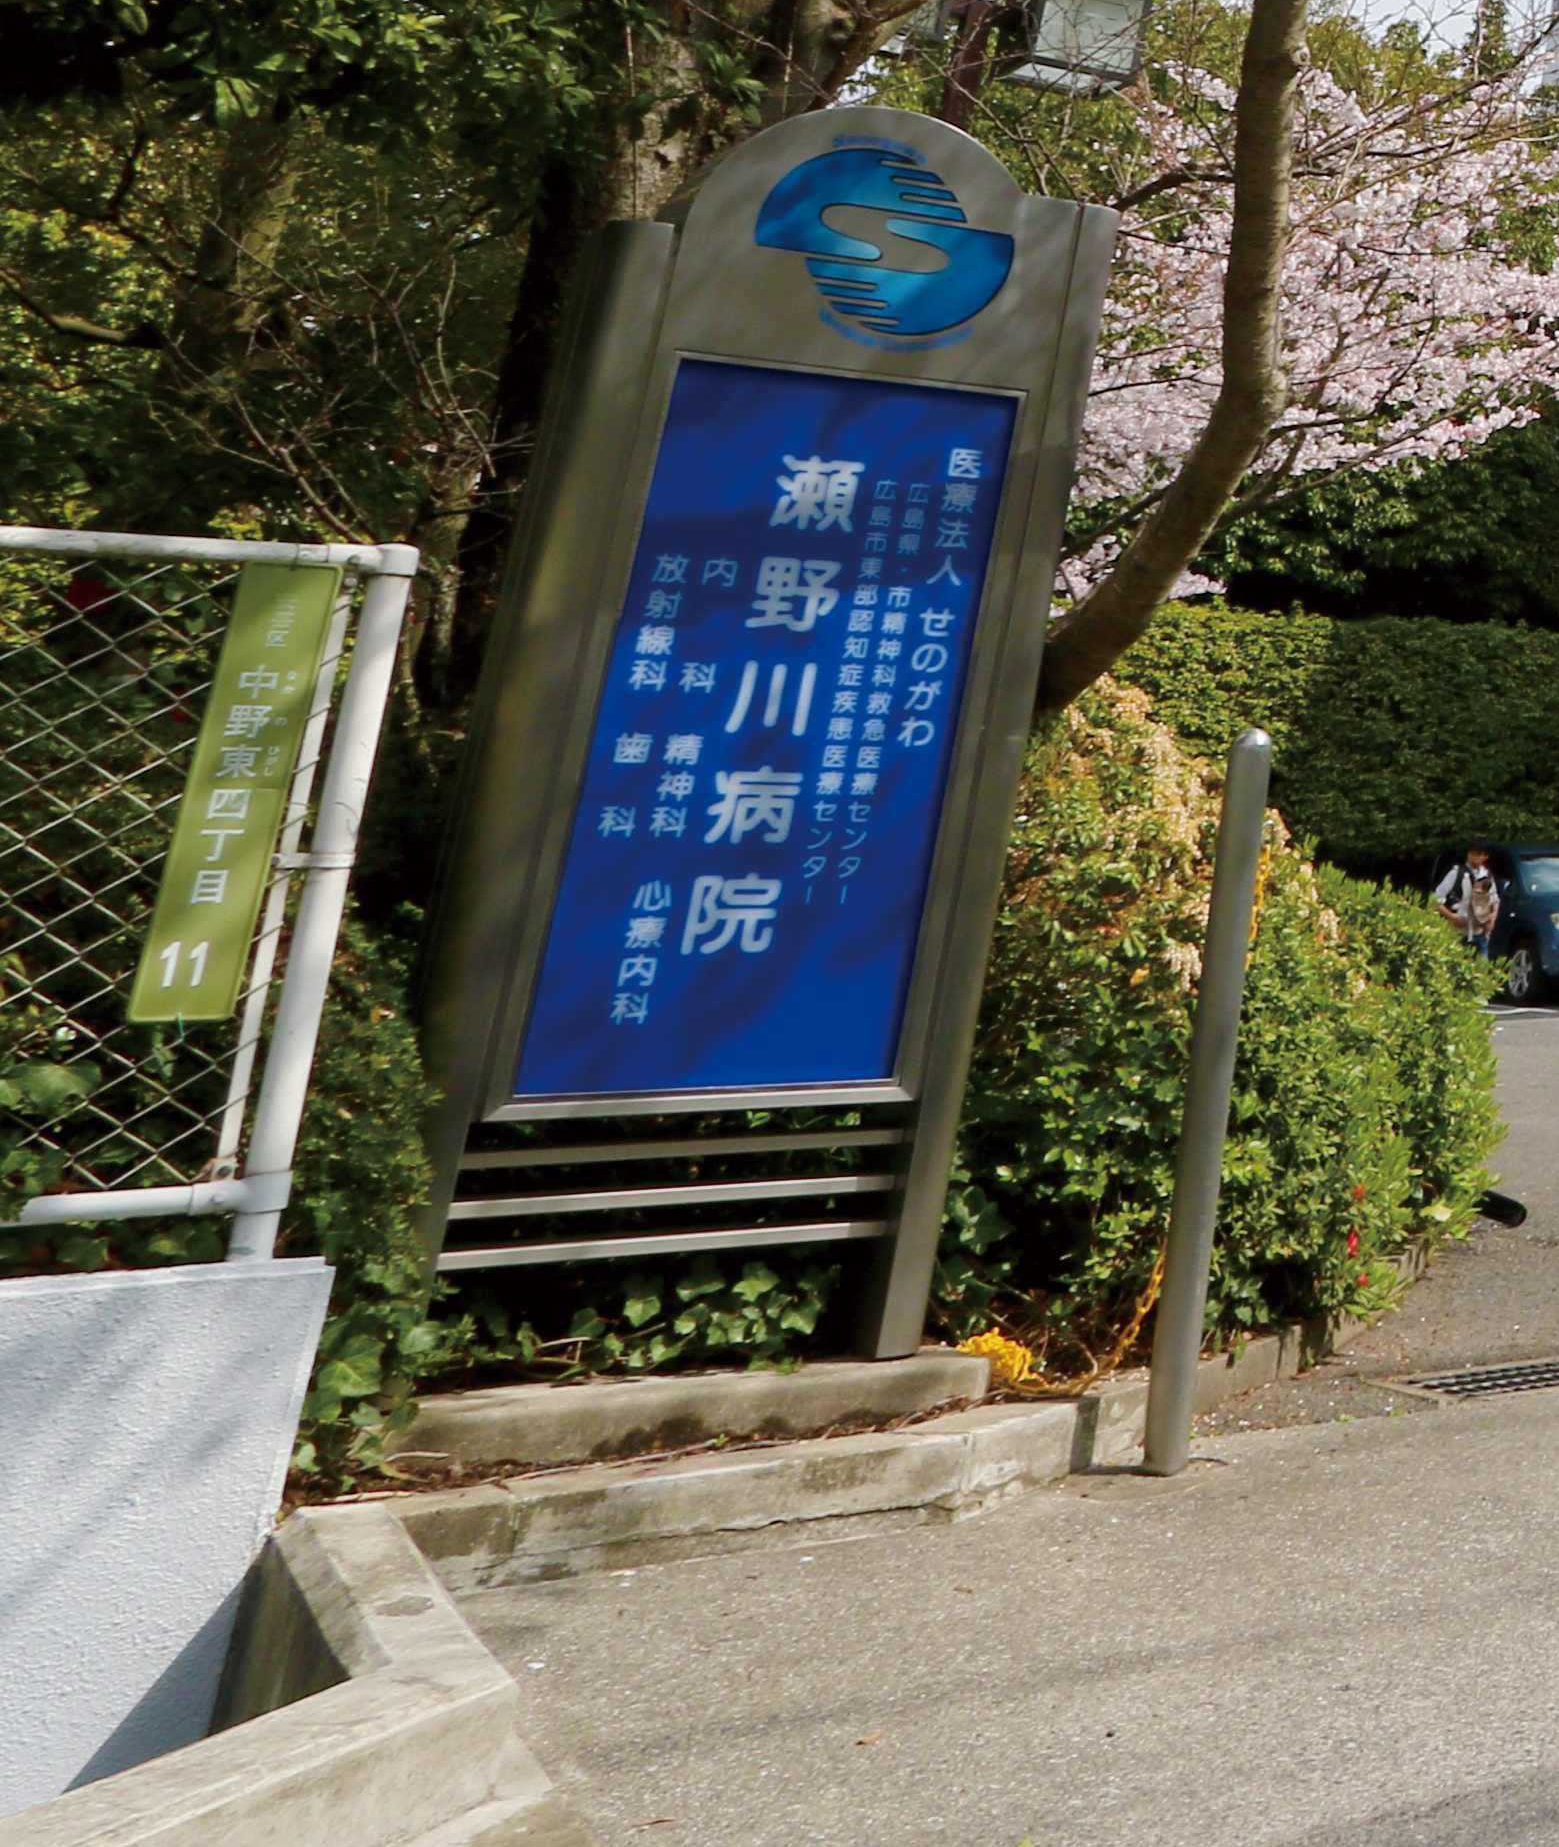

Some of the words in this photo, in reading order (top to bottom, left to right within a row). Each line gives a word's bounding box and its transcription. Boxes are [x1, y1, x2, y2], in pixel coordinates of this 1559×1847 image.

[190, 664, 280, 905] 中野東四丁目
[679, 453, 866, 956] 瀬野川病院
[160, 940, 209, 988] 11
